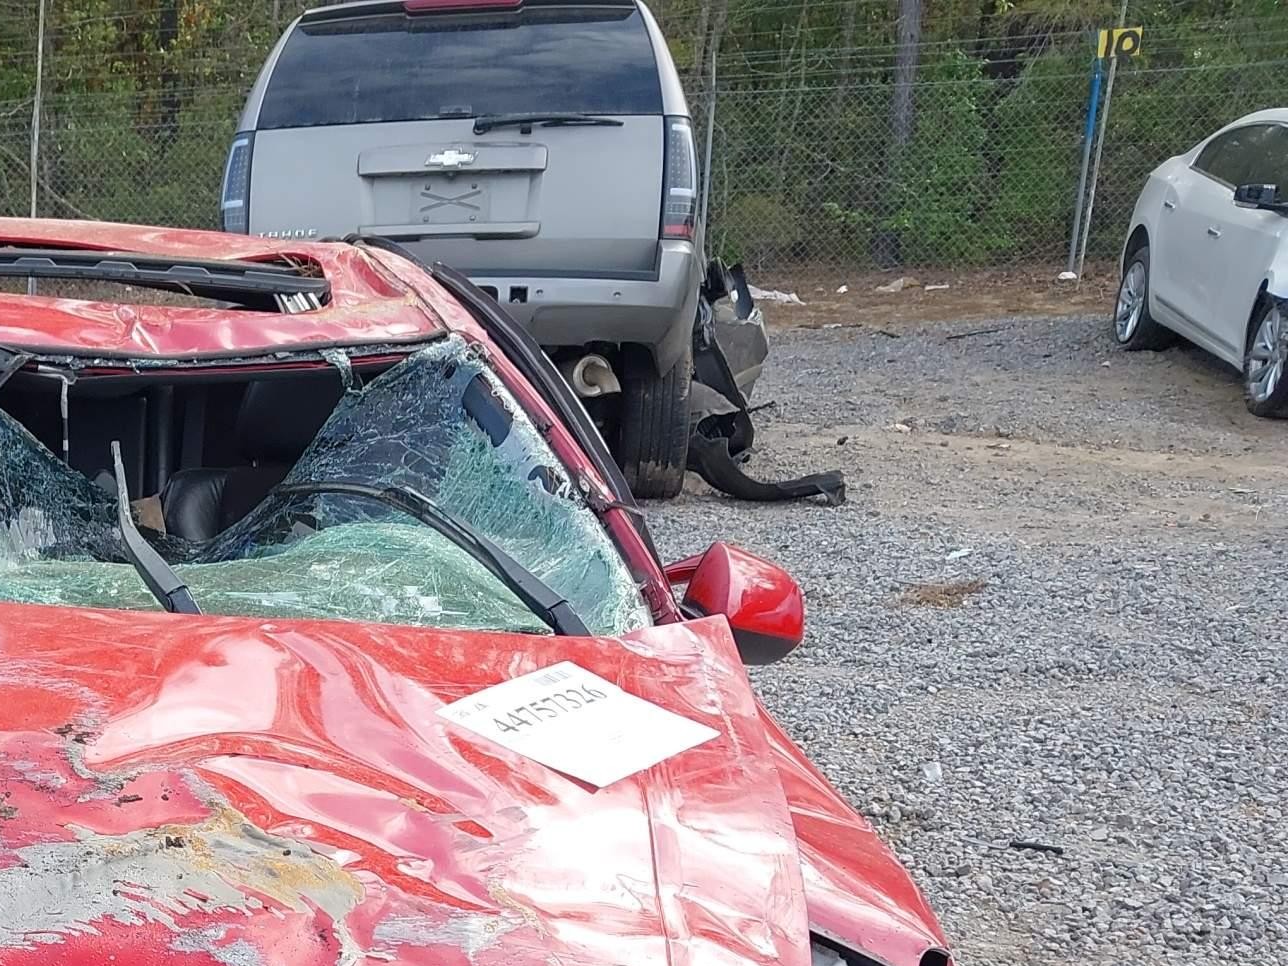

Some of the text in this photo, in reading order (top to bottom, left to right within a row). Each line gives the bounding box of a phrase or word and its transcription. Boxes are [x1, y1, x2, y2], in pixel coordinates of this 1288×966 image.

[1104, 28, 1141, 58] 10
[257, 228, 318, 240] TAHOE
[492, 683, 608, 734] 44757326
